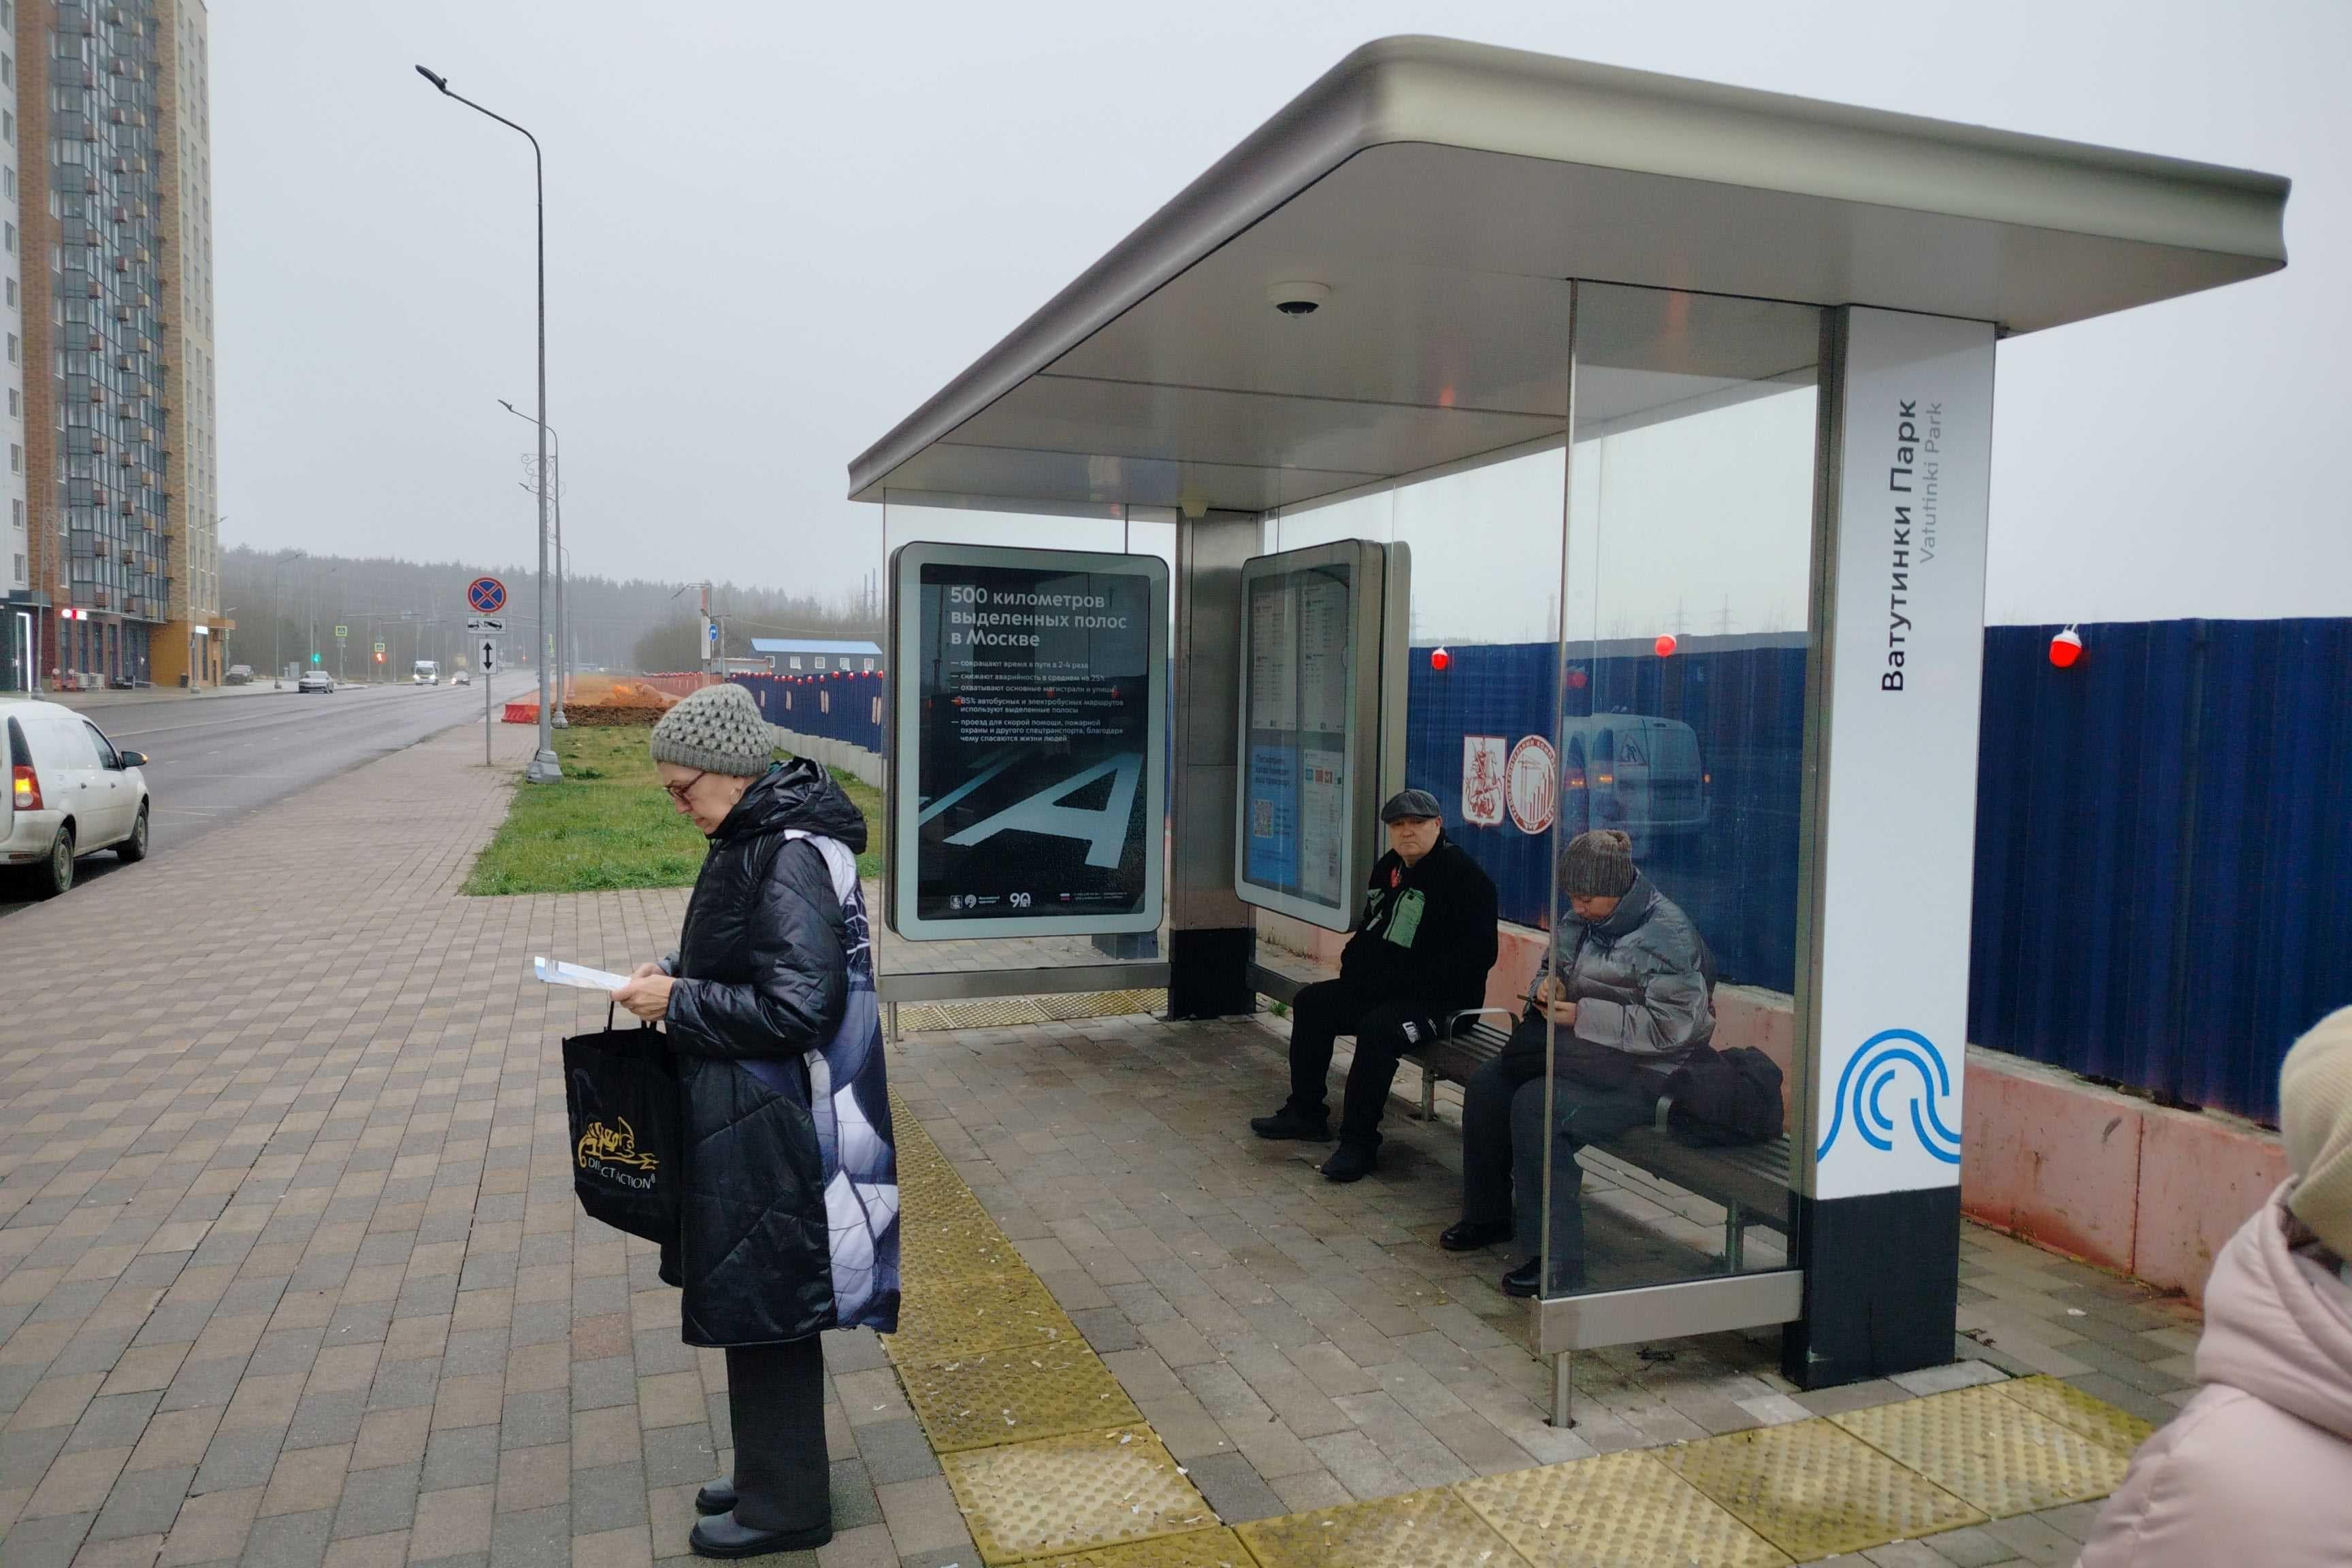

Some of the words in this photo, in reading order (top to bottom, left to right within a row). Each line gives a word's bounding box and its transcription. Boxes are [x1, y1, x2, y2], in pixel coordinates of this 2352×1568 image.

[1889, 398, 1920, 492] Парк
[1925, 402, 1942, 453] Park
[1921, 461, 1939, 564] Vatutinki
[950, 587, 987, 604] 500
[993, 592, 1105, 610] километров
[1881, 506, 1912, 691] Ватутинки
[951, 612, 1069, 627] выделенных
[1075, 615, 1128, 629] полос
[951, 633, 962, 644] в
[966, 629, 1041, 647] Москве
[978, 698, 1019, 706] автобусных
